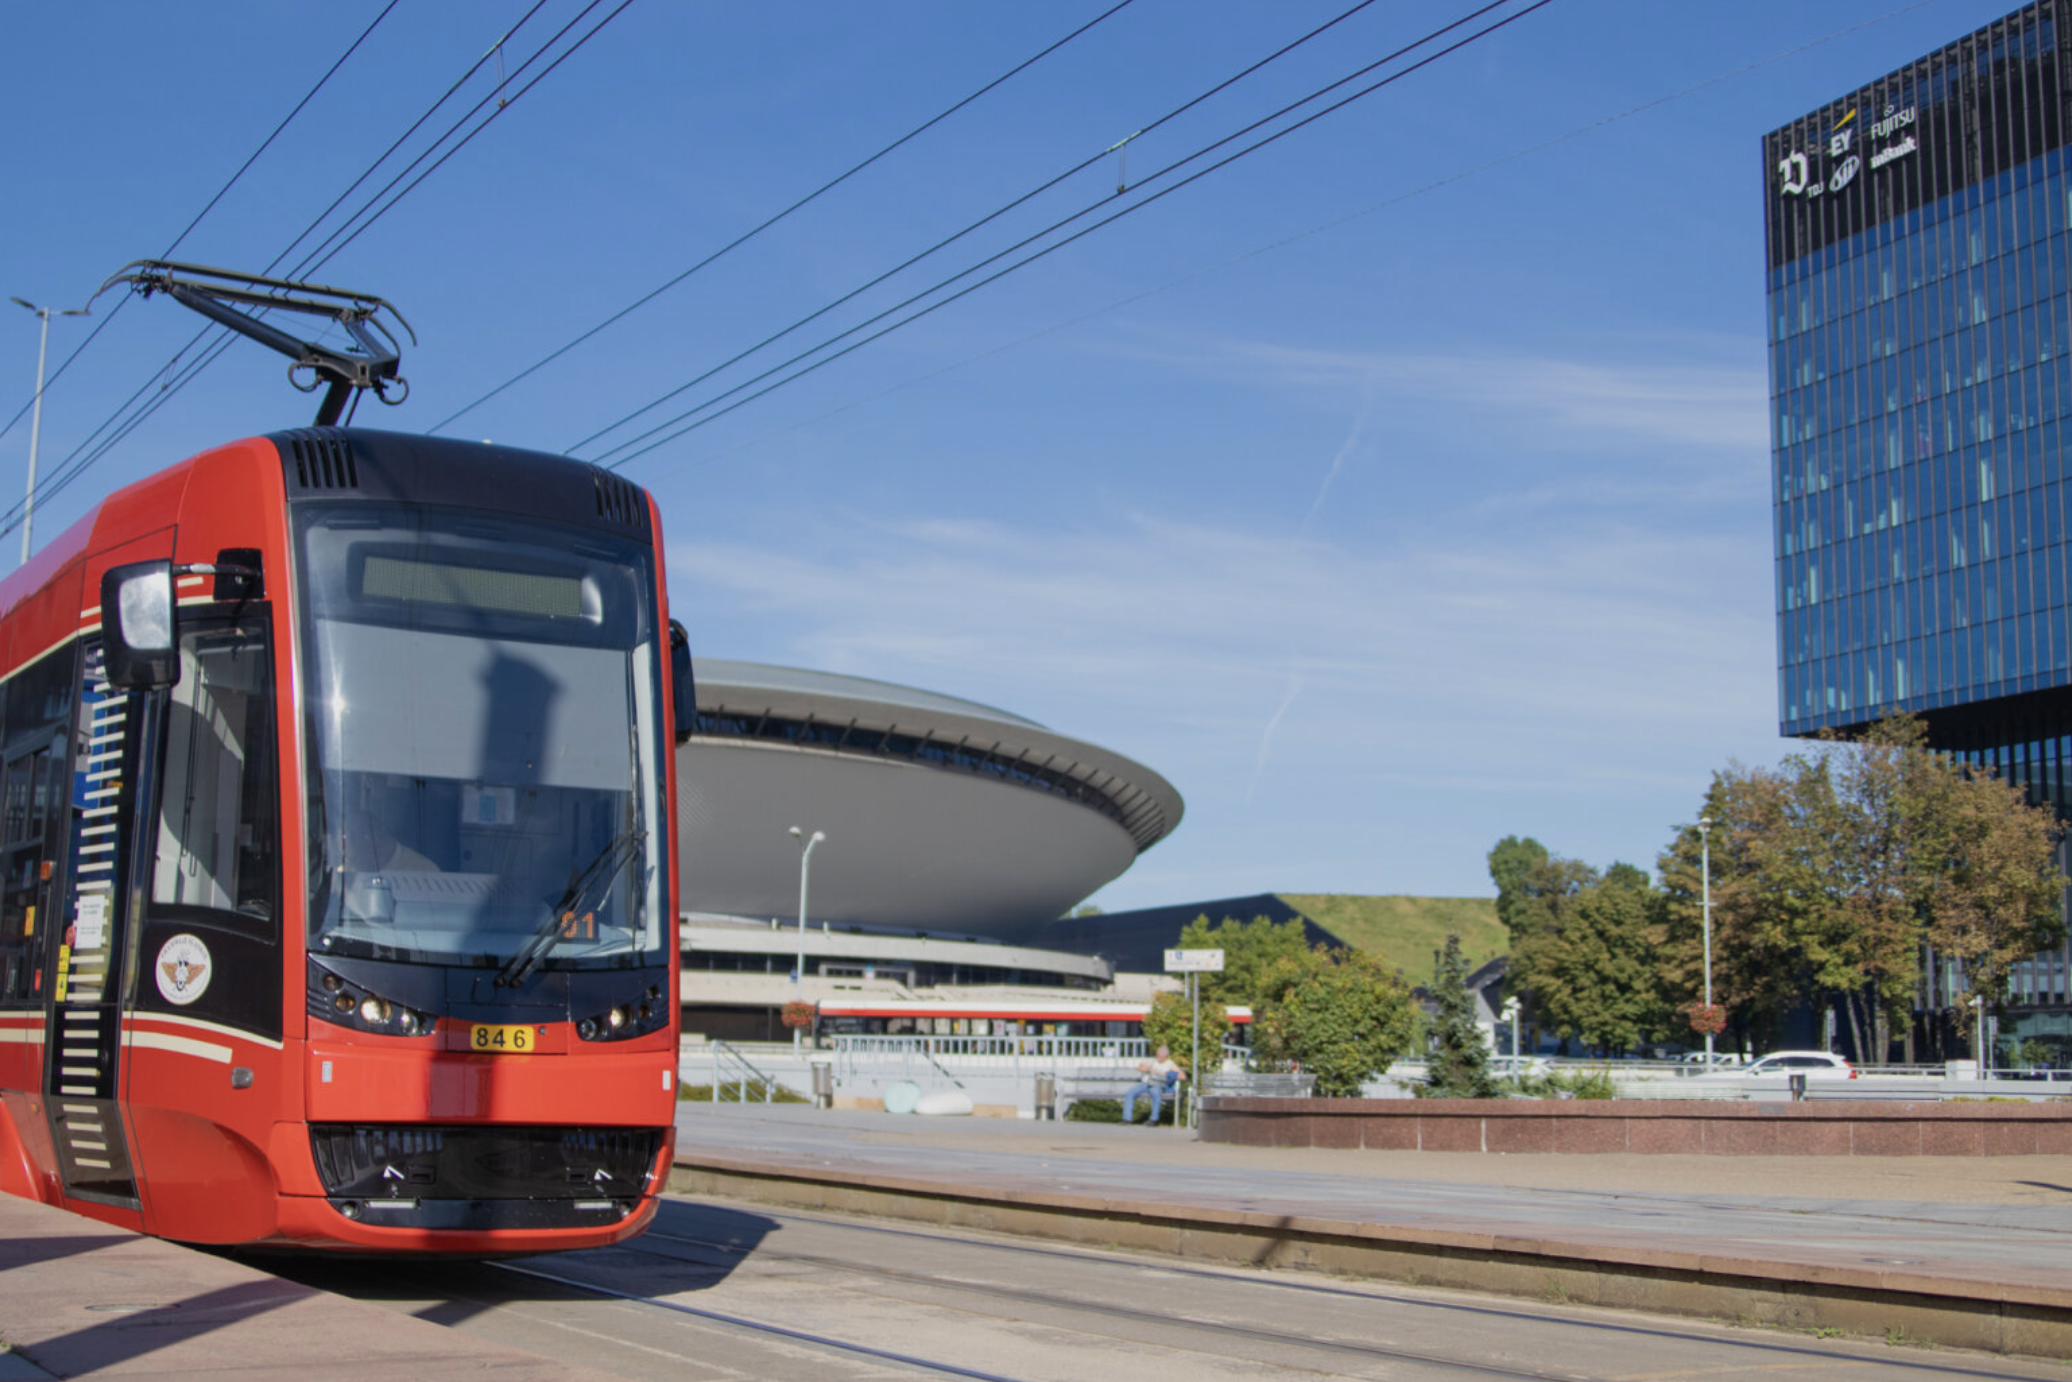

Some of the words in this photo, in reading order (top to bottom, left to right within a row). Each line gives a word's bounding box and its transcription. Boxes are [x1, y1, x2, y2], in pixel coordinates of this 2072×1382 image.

[1871, 106, 1915, 139] FUJITSU
[1831, 130, 1852, 157] EY
[1871, 136, 1917, 169] mBank
[1807, 181, 1824, 197] TDJ
[476, 1027, 526, 1049] 846
